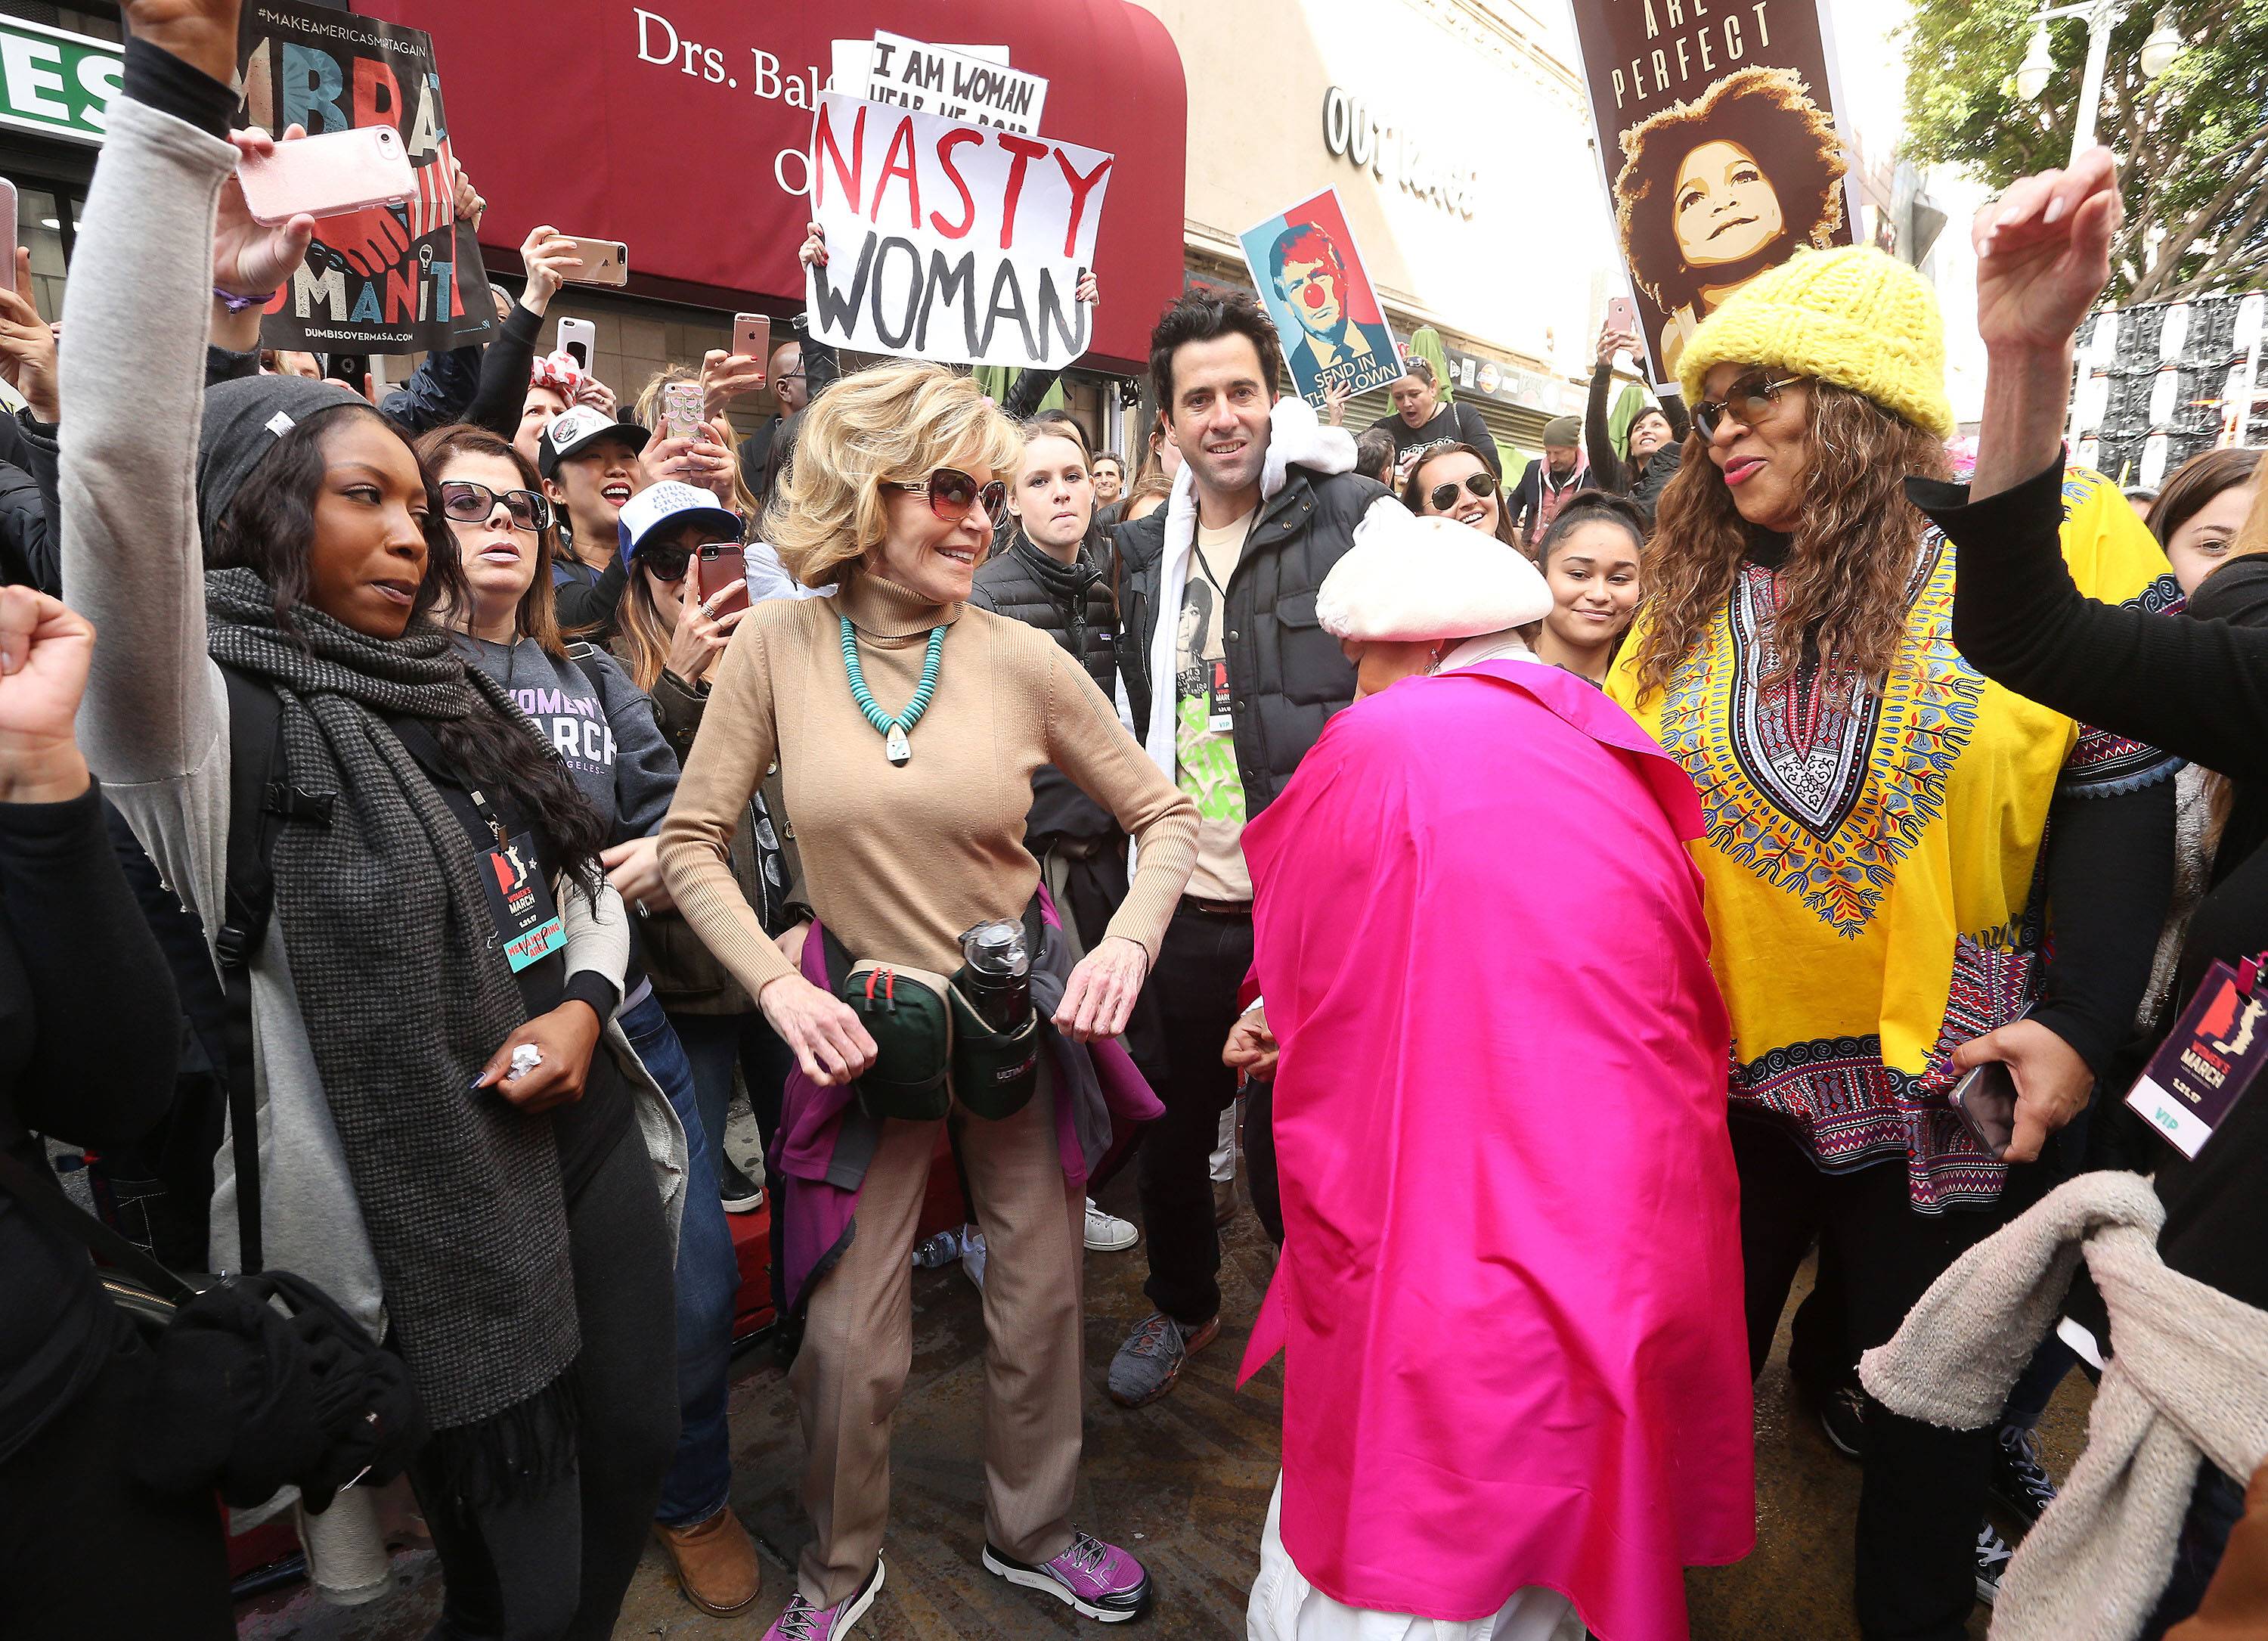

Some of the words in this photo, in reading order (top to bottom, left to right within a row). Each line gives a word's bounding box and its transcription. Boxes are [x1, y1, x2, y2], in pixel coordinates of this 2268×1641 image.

[633, 7, 738, 89] Drs.
[751, 48, 833, 112] Bal
[1611, 1, 1769, 110] PERFECT
[873, 42, 896, 78] I
[902, 51, 943, 92] AM
[953, 61, 1034, 116] WOMAN
[814, 101, 1114, 259] NASTY
[813, 231, 1087, 362] WOMAN
[305, 327, 414, 342] DUMBISOVERMASA.COM
[1304, 386, 1328, 408] TH
[1350, 363, 1397, 392] LOWN
[1314, 363, 1356, 389] SEND
[1358, 354, 1377, 372] IN
[509, 893, 535, 914] MARCH
[2180, 1047, 2226, 1089] MARCH
[2155, 1107, 2179, 1130] VIP
